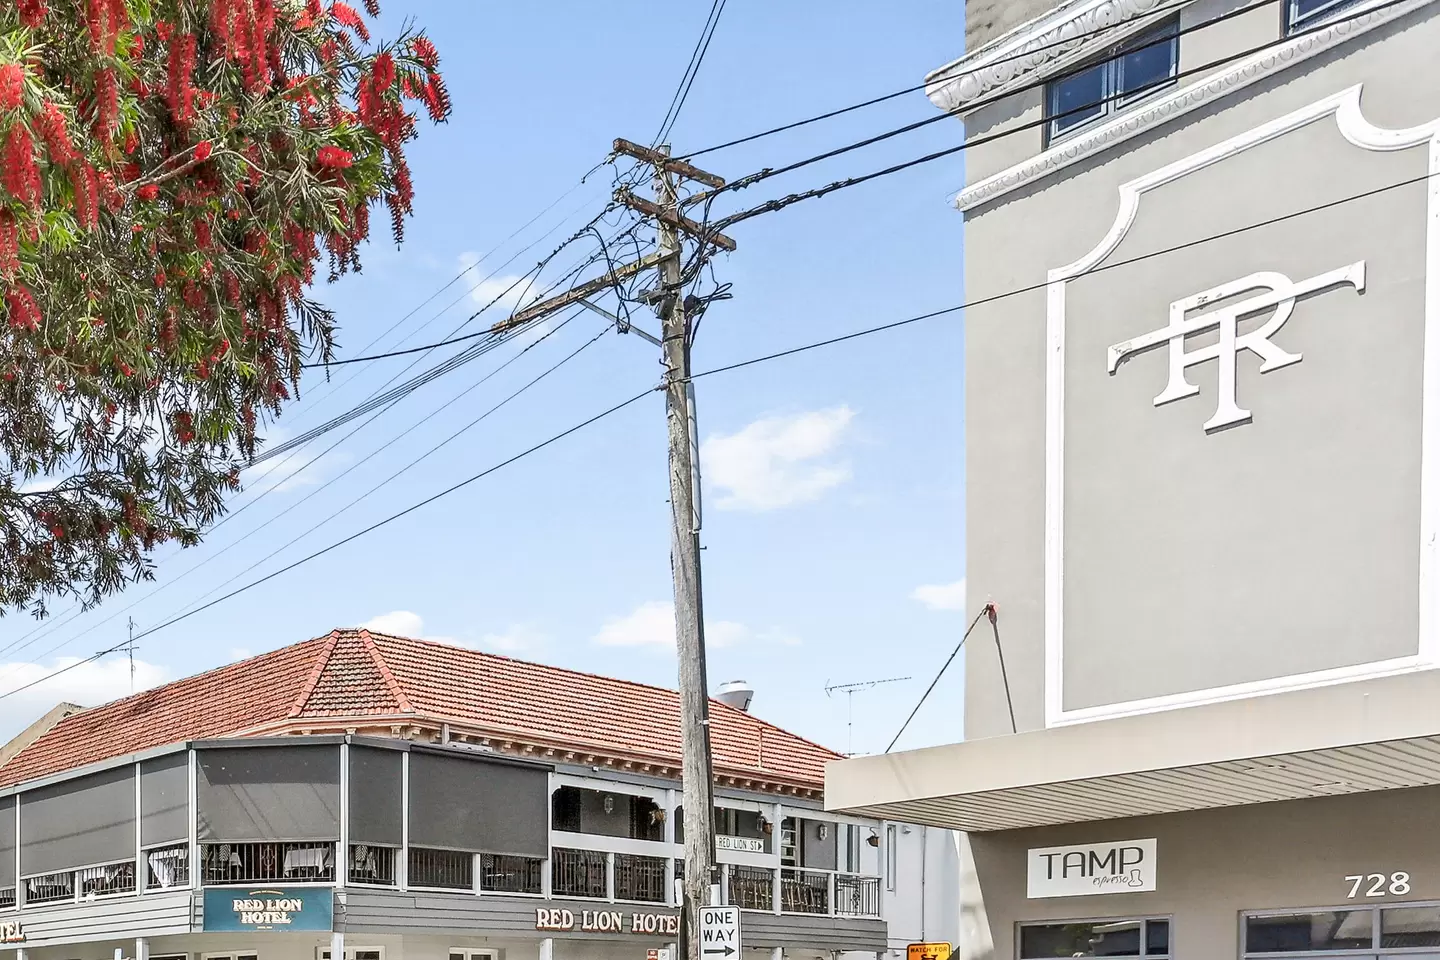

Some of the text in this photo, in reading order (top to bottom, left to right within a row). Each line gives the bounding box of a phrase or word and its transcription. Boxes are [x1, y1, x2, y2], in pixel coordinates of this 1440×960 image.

[719, 837, 757, 851] RED LION ST
[1039, 847, 1143, 879] TAMP
[1092, 875, 1128, 888] espresso
[1345, 871, 1411, 899] 728
[233, 898, 303, 912] RED LION
[241, 911, 292, 924] HOTEL
[535, 908, 575, 931] RED
[582, 910, 623, 933] LION
[705, 911, 733, 925] ONE
[703, 929, 735, 942] WAY
